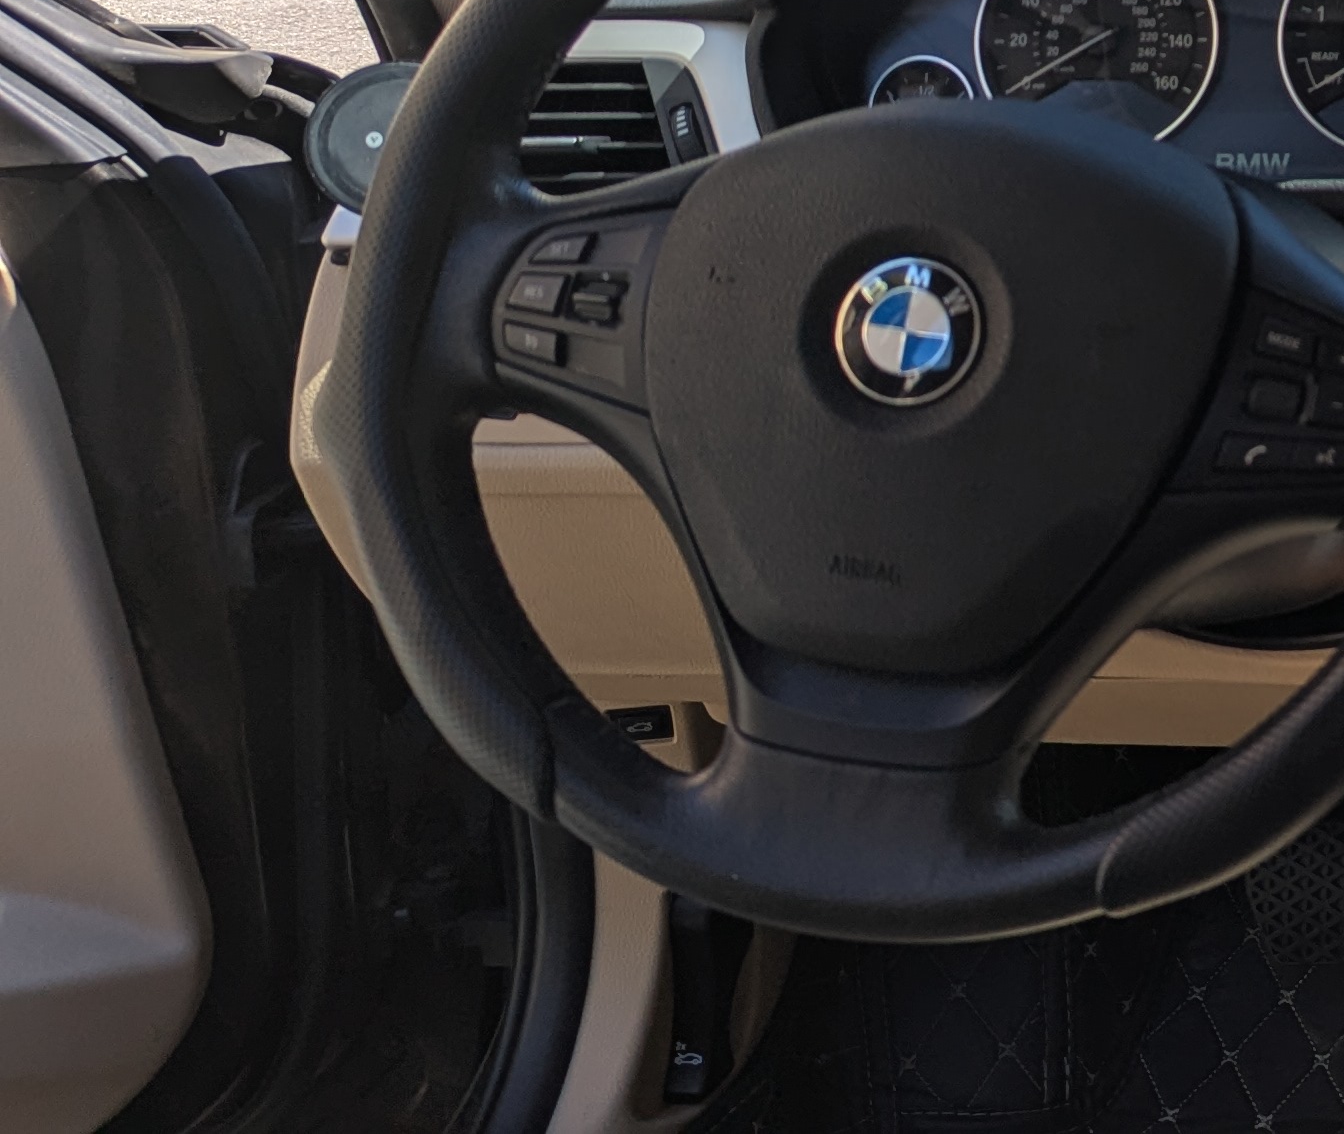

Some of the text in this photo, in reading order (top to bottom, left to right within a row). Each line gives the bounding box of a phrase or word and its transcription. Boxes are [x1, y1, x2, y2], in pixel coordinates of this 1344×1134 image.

[1317, 5, 1325, 22] 1
[1009, 32, 1028, 47] 20
[1169, 33, 1193, 48] 140
[1154, 75, 1179, 90] 160
[1216, 152, 1291, 177] BMW
[860, 264, 971, 316] BMW
